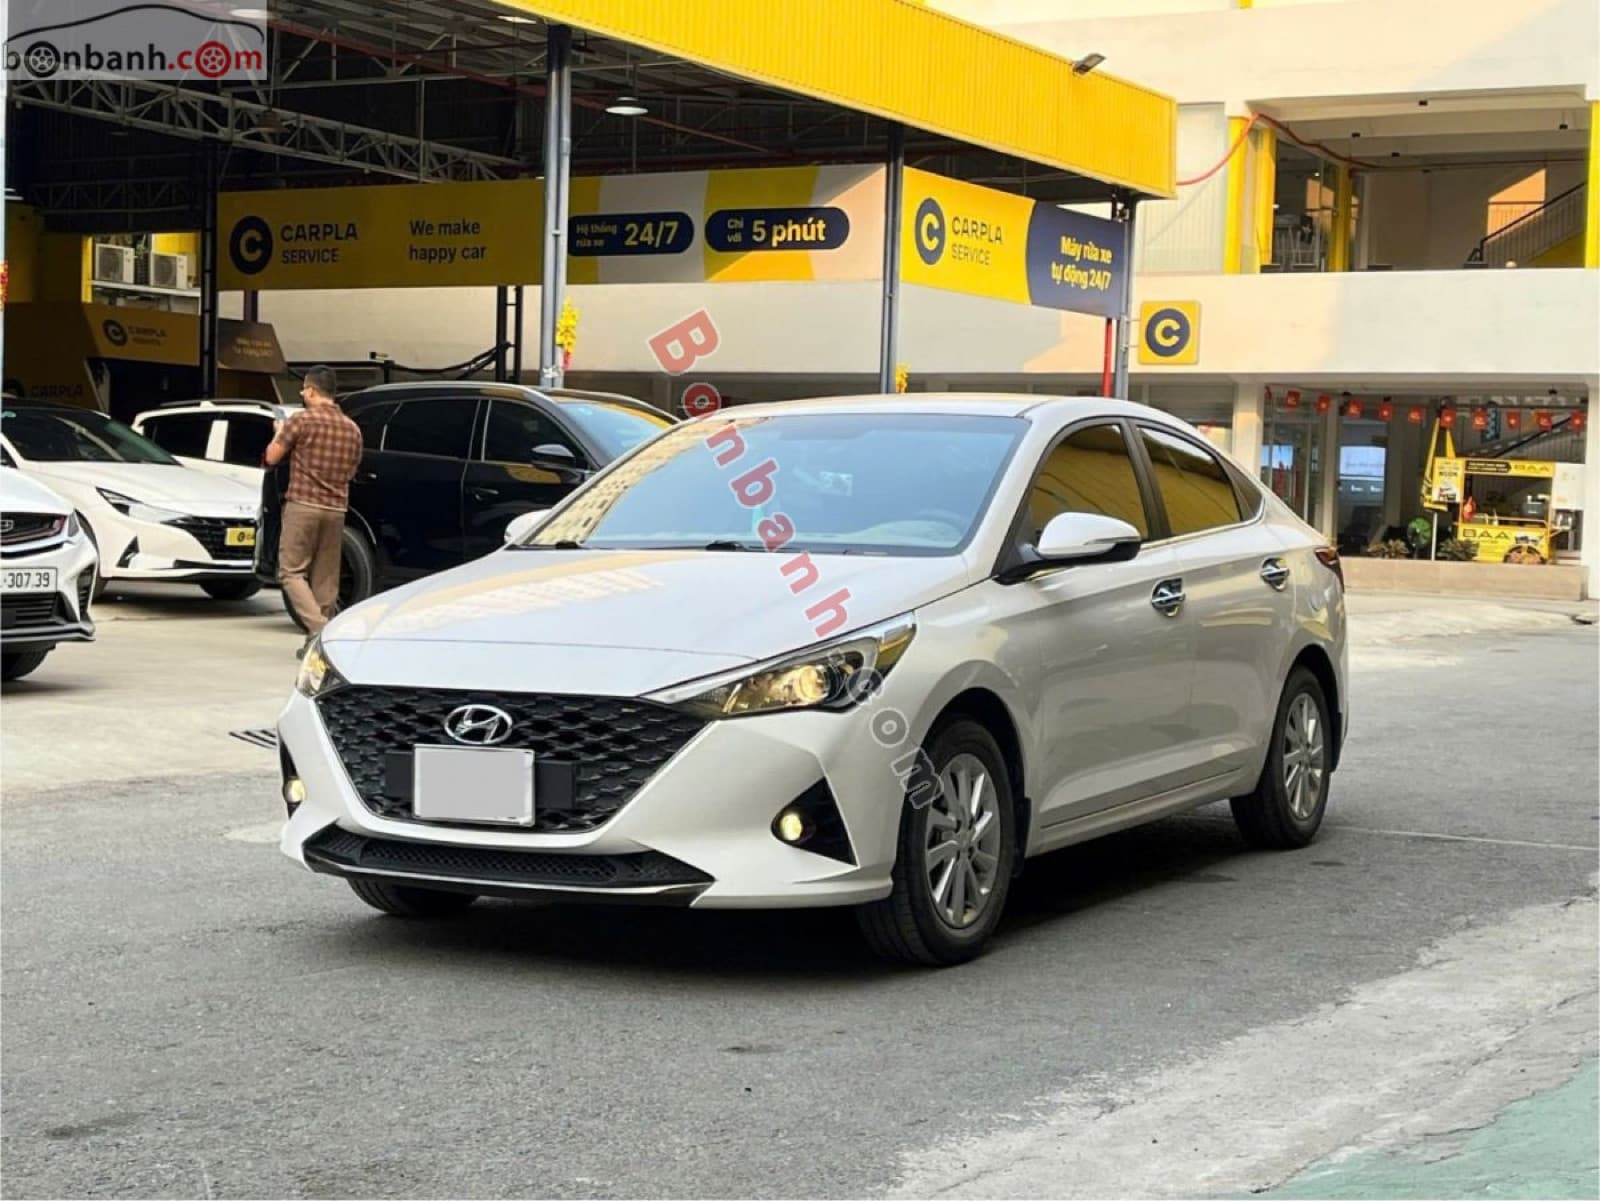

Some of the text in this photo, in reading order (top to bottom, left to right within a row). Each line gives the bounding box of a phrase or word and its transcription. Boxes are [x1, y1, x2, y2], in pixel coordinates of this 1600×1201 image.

[280, 222, 359, 242] CARPLA
[410, 219, 481, 236] We make
[623, 220, 679, 248] 24/7
[751, 216, 827, 247] 5 phút
[951, 215, 1004, 244] CARPLA
[281, 247, 340, 265] SERVICE
[409, 244, 488, 263] happy car
[951, 243, 991, 267] SERVICE
[1060, 235, 1083, 262] Máy
[1100, 247, 1113, 265] xe
[1063, 263, 1089, 290] động
[1088, 268, 1113, 291] 24/7
